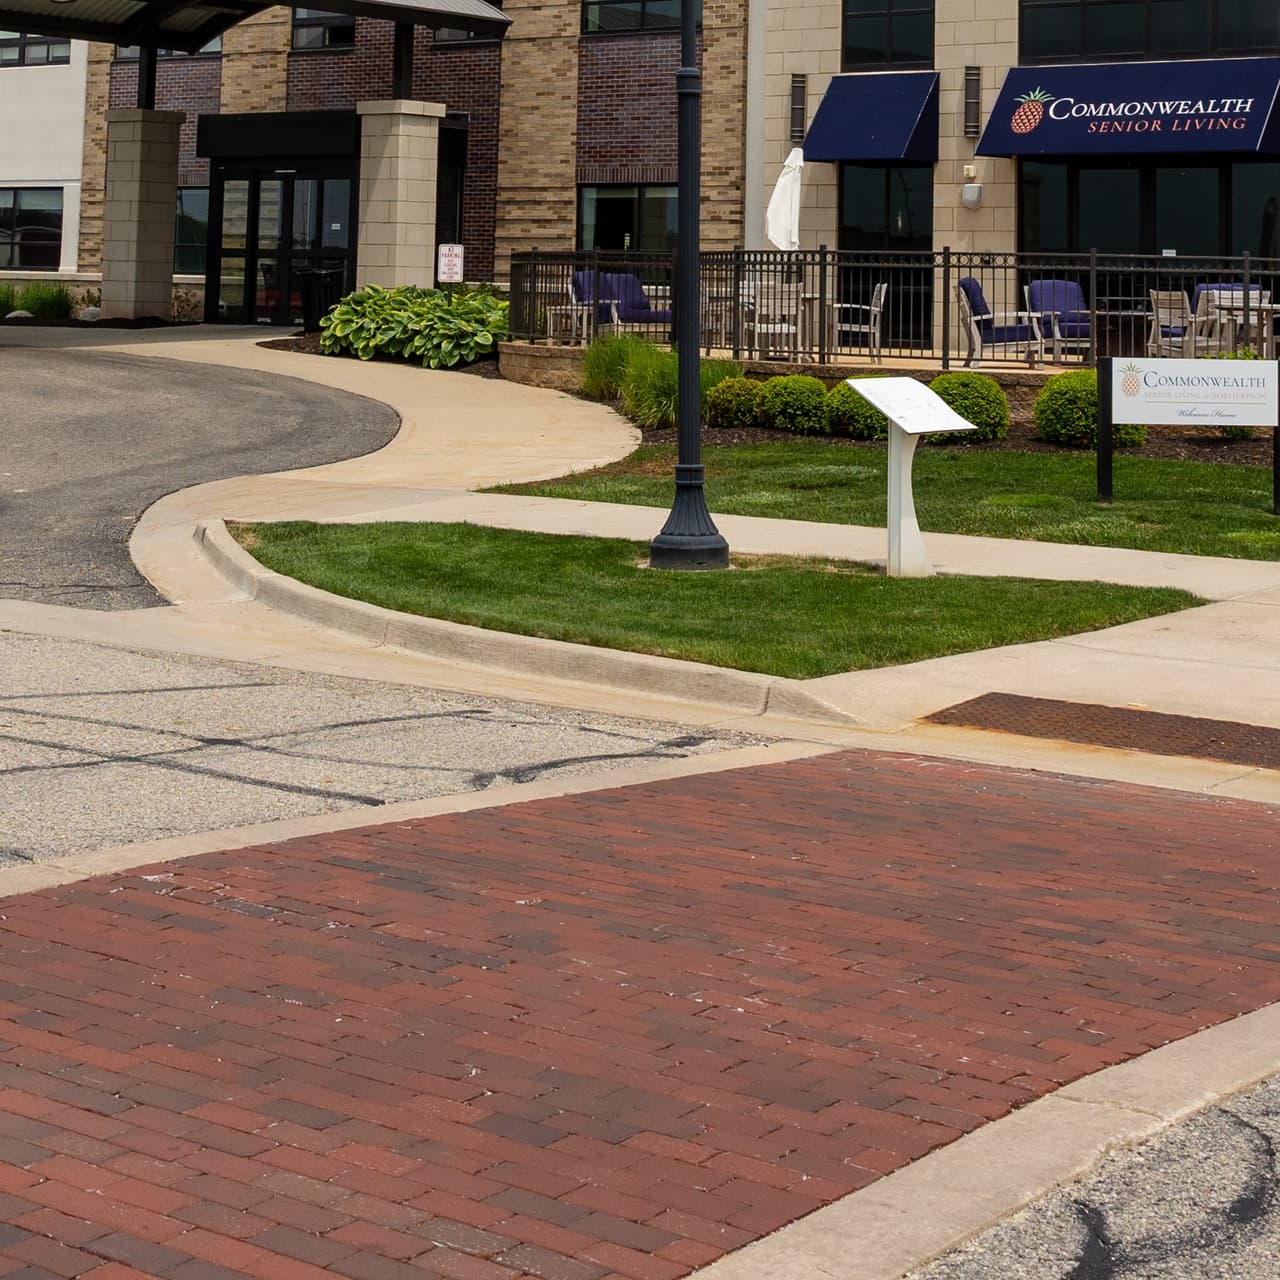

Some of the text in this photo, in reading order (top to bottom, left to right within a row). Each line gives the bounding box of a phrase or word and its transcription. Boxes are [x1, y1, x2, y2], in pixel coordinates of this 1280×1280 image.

[1049, 98, 1255, 120] COMMONWEALTH
[1088, 118, 1247, 133] SENIOR LIVING
[1144, 370, 1266, 388] COMMONWEALTH
